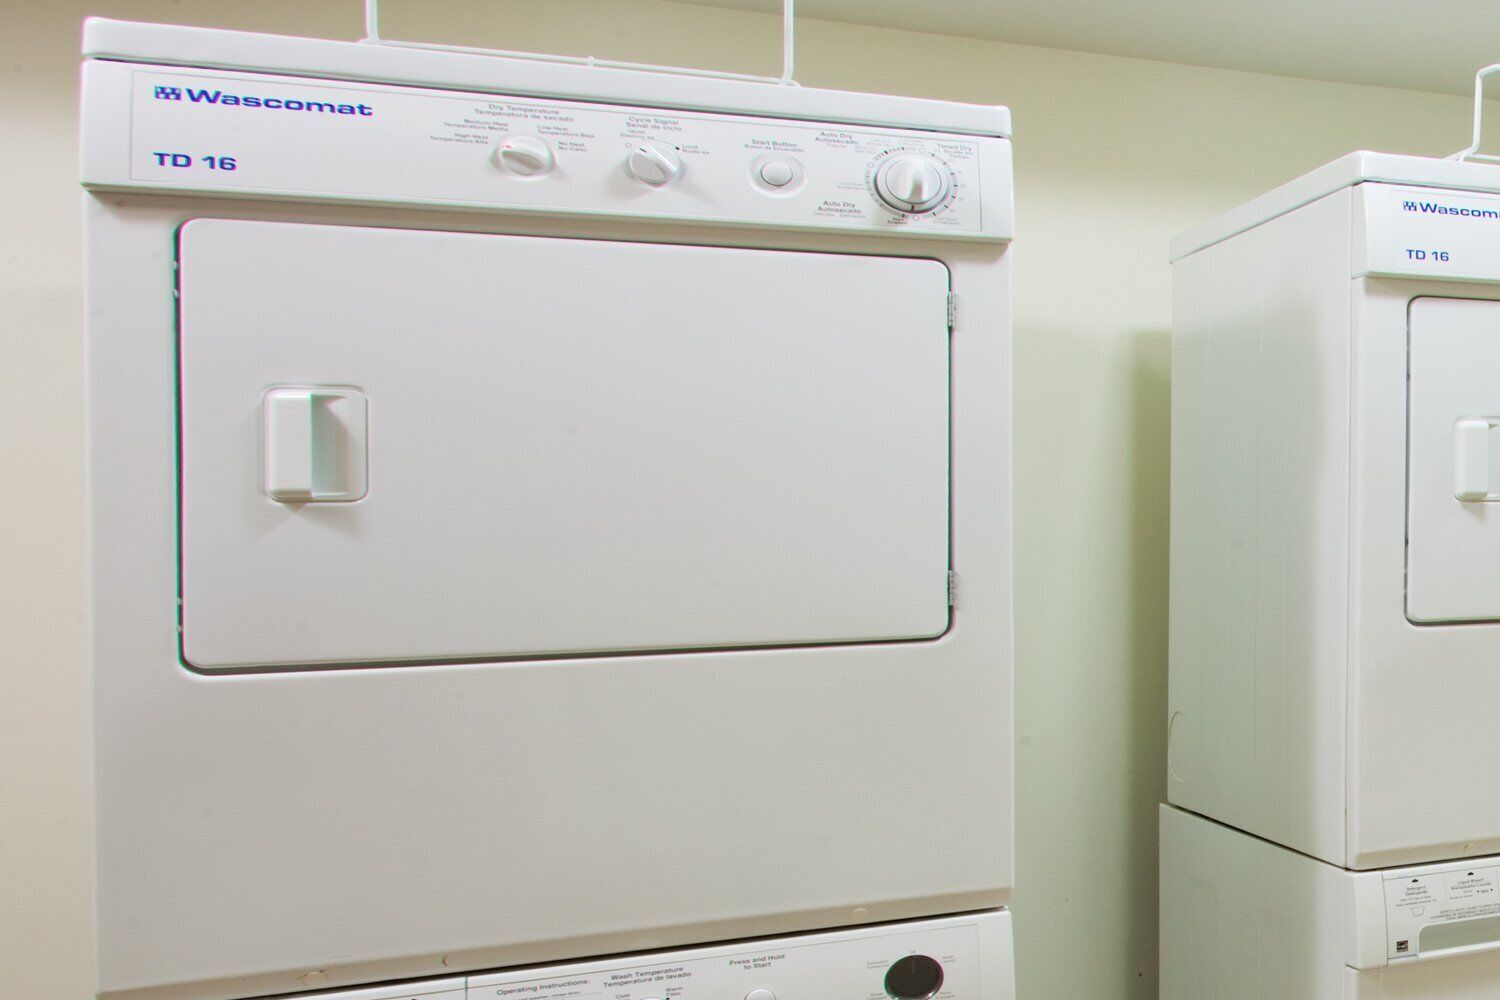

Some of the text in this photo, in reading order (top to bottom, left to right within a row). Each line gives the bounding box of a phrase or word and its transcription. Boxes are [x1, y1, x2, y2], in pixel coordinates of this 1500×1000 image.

[185, 87, 374, 117] Wascomat
[473, 108, 529, 120] Temperatura
[489, 103, 560, 116] Dry Temperature
[629, 116, 652, 124] Cycle
[815, 137, 859, 146] Autosecado
[840, 133, 852, 141] Dry
[772, 140, 798, 148] Button
[153, 152, 237, 171] TD 16
[823, 200, 841, 208] Auto
[818, 206, 861, 215] Autosecado
[1406, 248, 1449, 262] TD 16
[768, 953, 785, 961] Hold
[753, 961, 771, 969] Start
[611, 967, 684, 981] Wash Temperature
[603, 978, 653, 988] Temperatura
[666, 972, 692, 980] lavado
[497, 985, 538, 997] Operating
